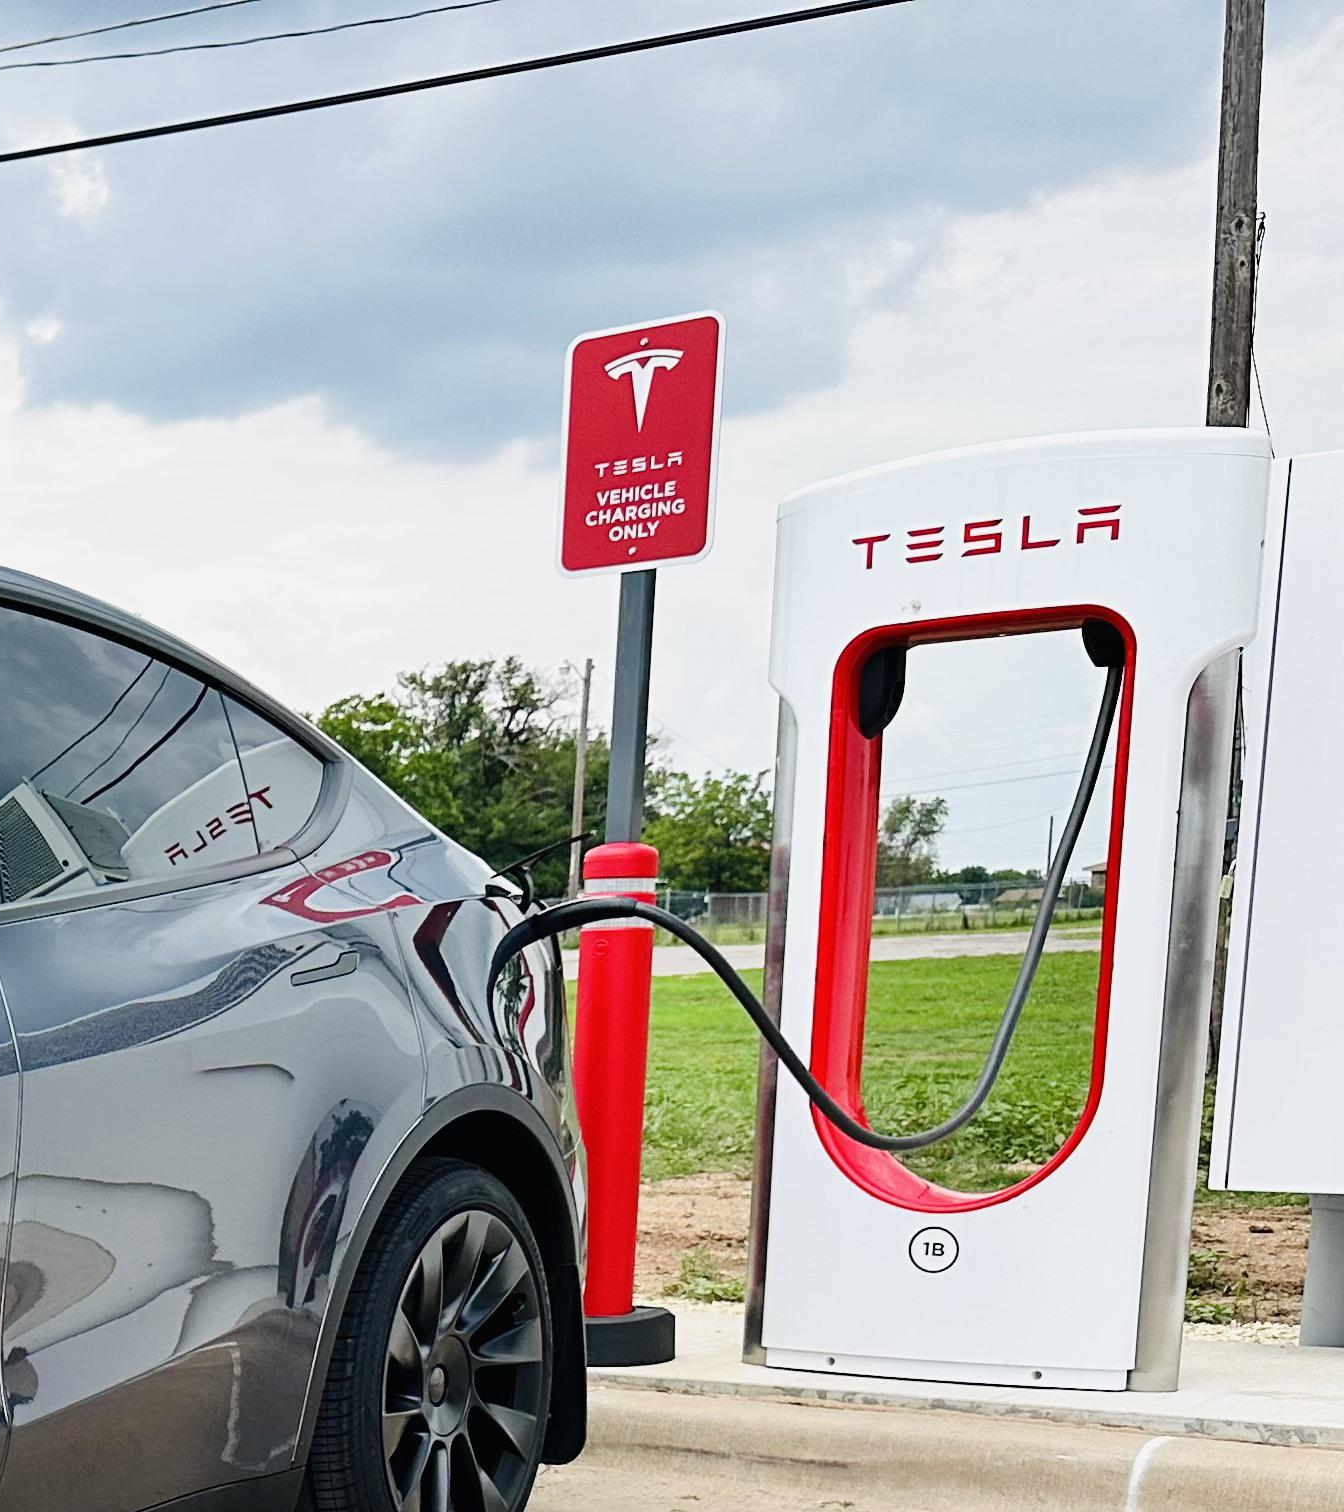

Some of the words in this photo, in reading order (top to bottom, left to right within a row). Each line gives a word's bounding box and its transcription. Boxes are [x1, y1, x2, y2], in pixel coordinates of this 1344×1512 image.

[594, 451, 683, 478] TESLA
[596, 480, 677, 507] VEHICLE
[584, 498, 686, 527] CHARGING
[608, 520, 660, 542] ONLY
[851, 504, 1123, 570] TESLA
[922, 1241, 945, 1257] 1B
